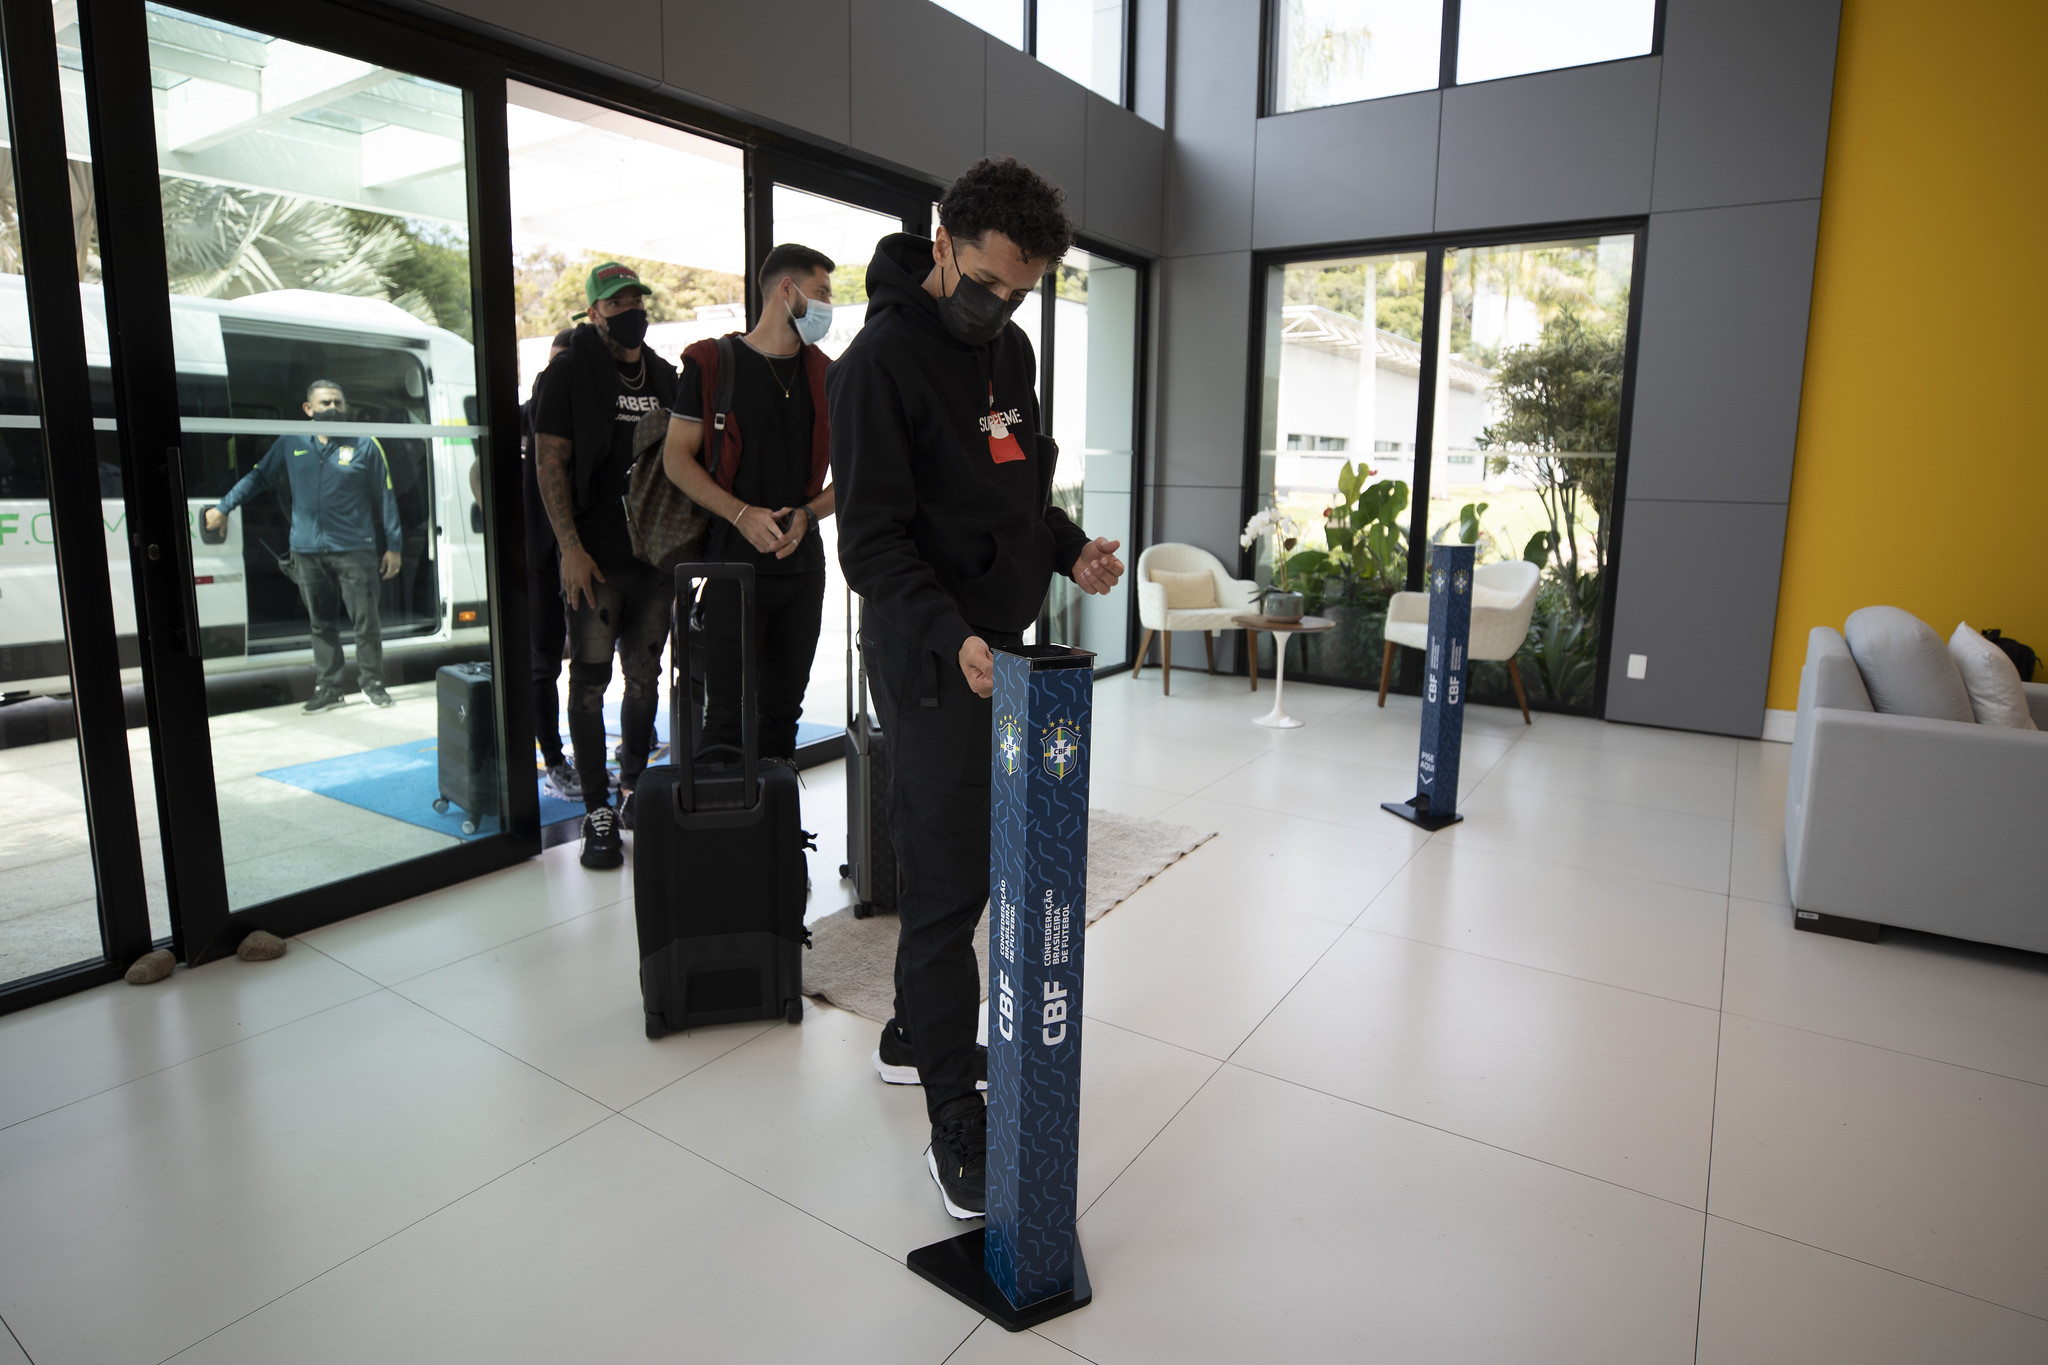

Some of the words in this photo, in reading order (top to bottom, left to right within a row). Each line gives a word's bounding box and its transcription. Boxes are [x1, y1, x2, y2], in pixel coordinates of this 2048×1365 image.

[616, 395, 660, 411] RBER
[1428, 673, 1438, 704] CBF
[1448, 676, 1460, 705] CBF
[1053, 747, 1068, 755] CBF
[1044, 889, 1054, 967] CONFEDERAÇÃO
[1052, 908, 1061, 965] BRASILEIRA
[1062, 904, 1070, 948] FUTEBOL
[1009, 949, 1015, 964] DE
[1061, 949, 1069, 963] DE
[999, 969, 1014, 1042] CBF
[1042, 981, 1068, 1046] CBF
